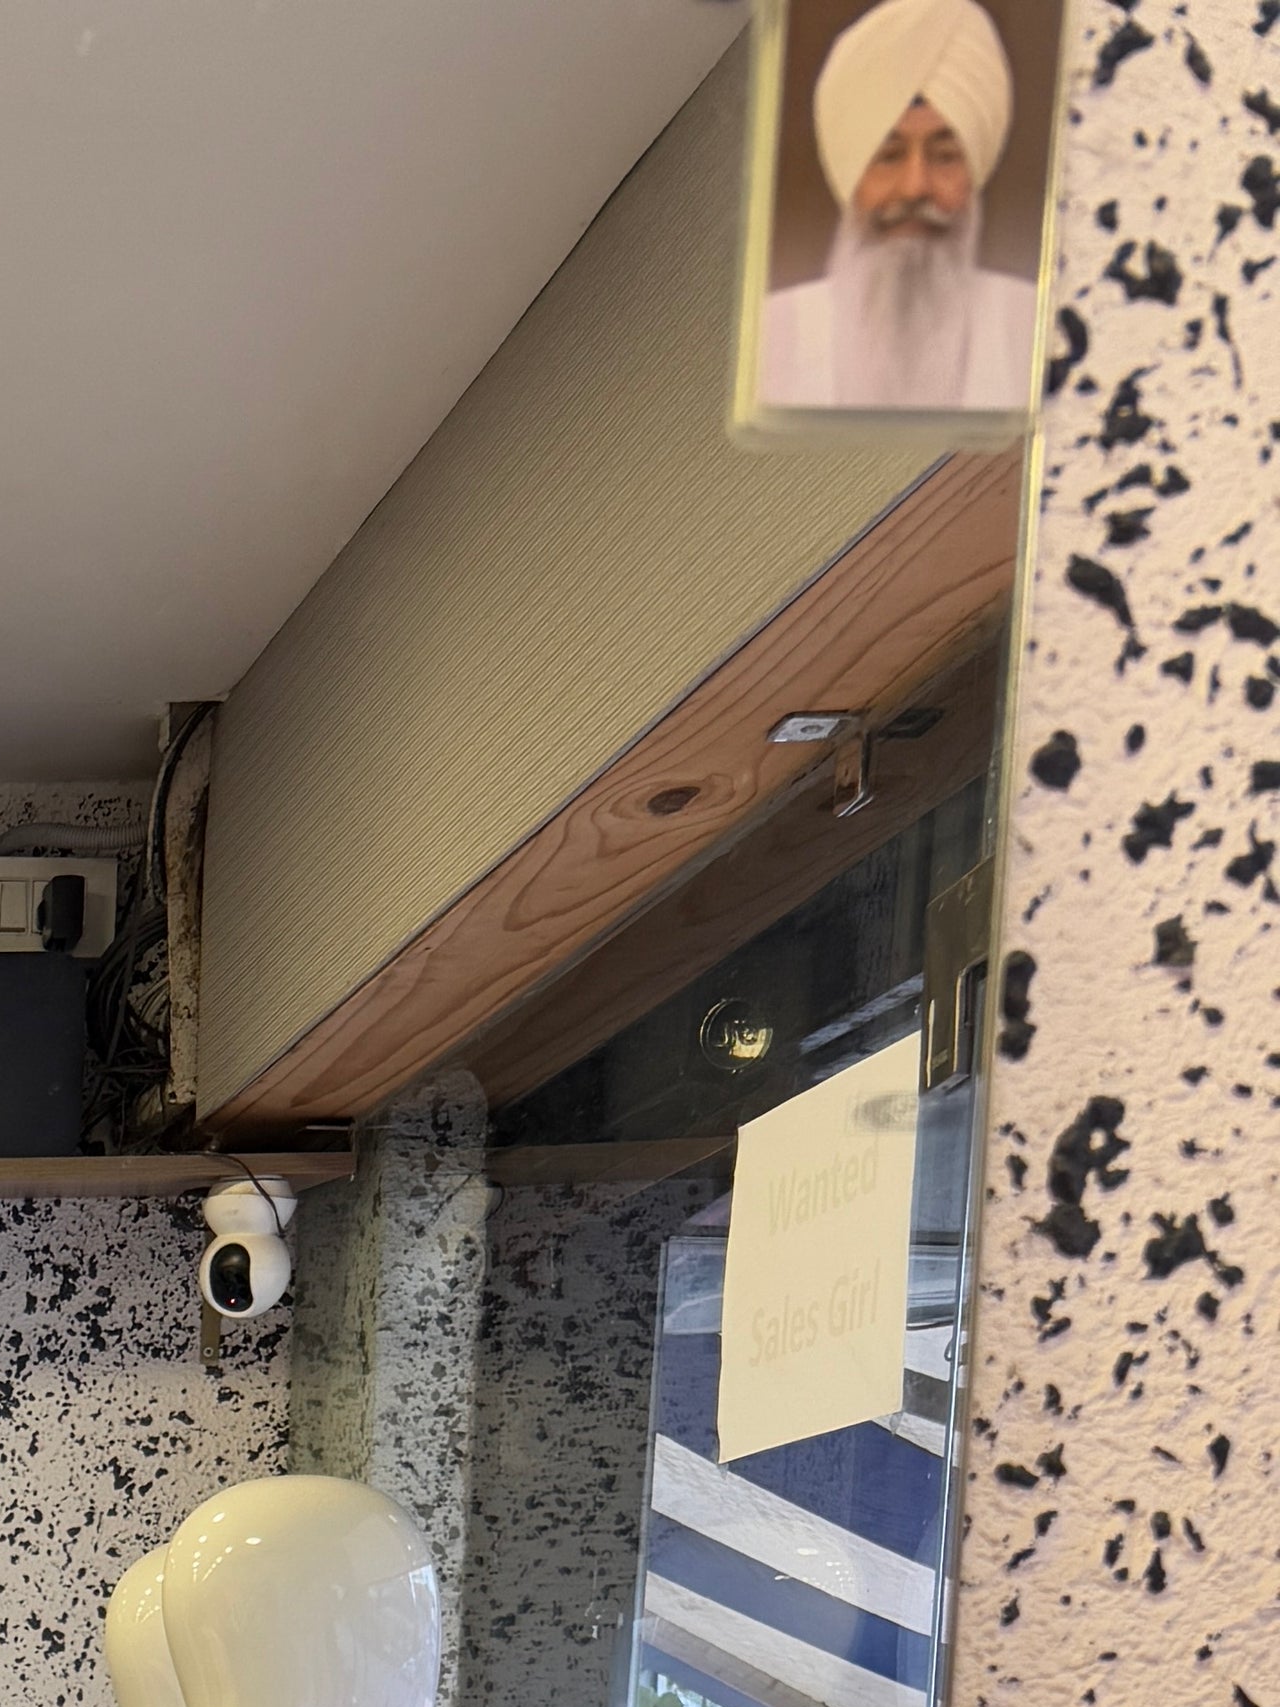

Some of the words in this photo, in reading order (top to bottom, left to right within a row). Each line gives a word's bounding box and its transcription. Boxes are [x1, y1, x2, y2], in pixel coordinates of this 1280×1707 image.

[768, 1135, 880, 1236] Wanted
[748, 1294, 819, 1368] Sales
[828, 1257, 881, 1338] Girl
